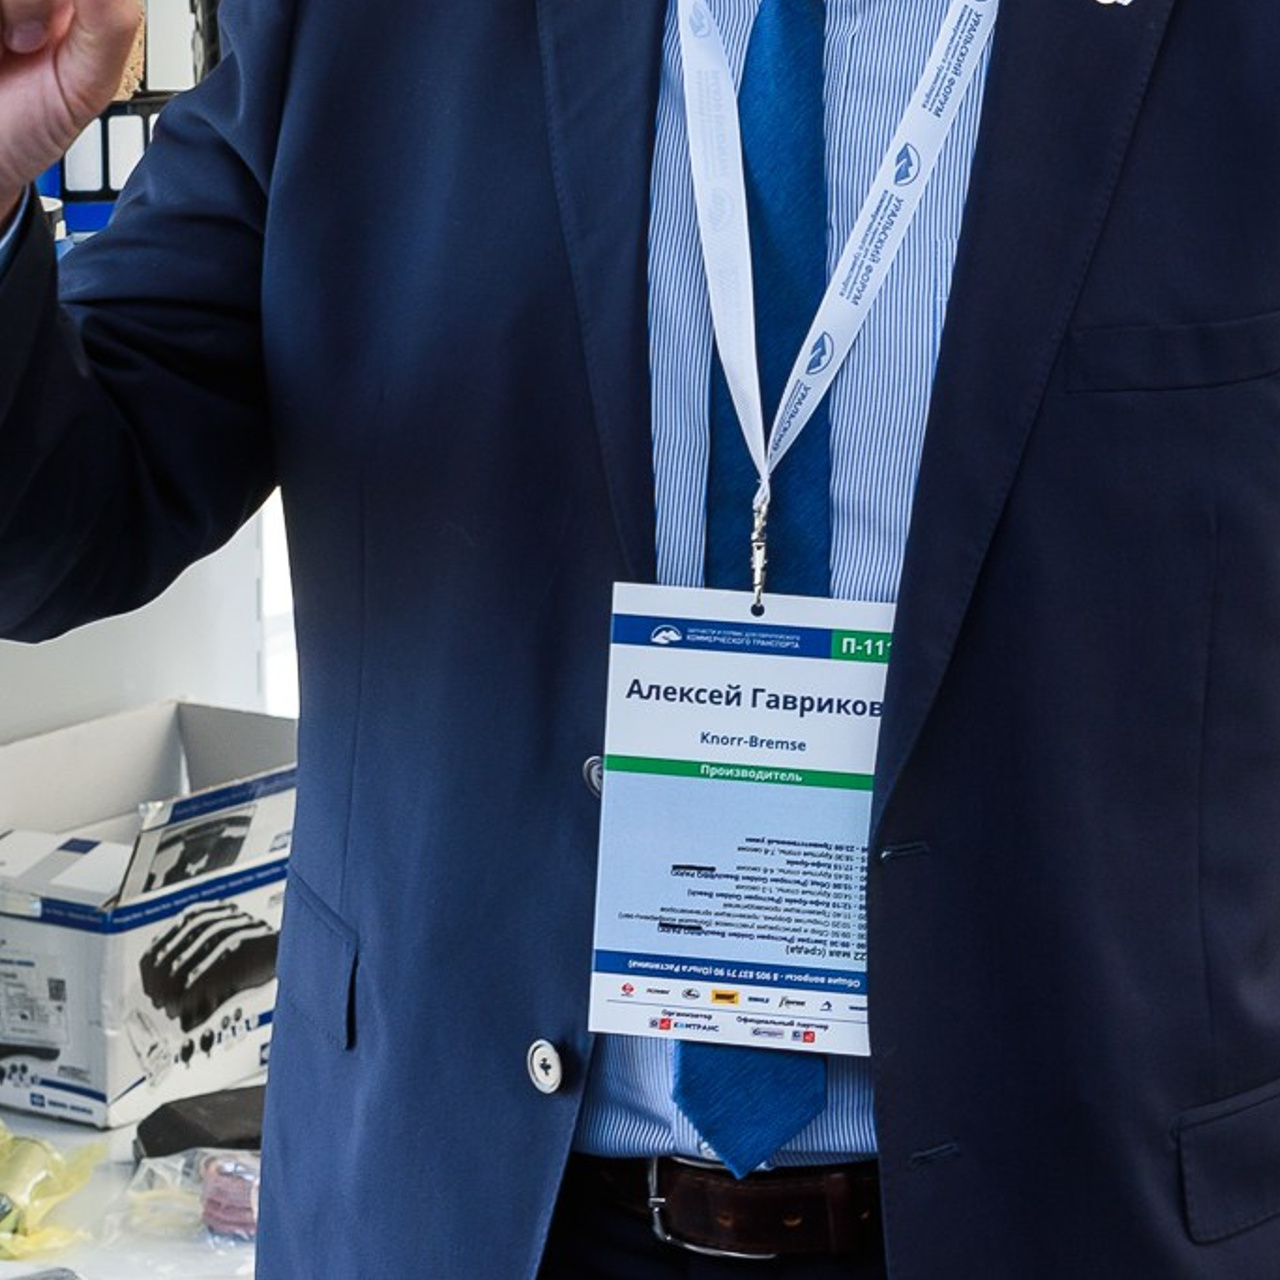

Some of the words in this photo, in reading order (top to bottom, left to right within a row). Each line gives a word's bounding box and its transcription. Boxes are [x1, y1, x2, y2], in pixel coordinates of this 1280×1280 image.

[949, 11, 983, 77] УРАЛЬСКИЙ
[932, 76, 957, 118] ФОРУМ
[867, 196, 904, 264] УРАЛЬСКИЙ
[849, 263, 874, 306] ФОРУМ
[686, 633, 751, 646] КОММЕРЧЕСКОГО
[751, 638, 799, 649] ТРАНСПОРТА
[626, 678, 742, 707] Алексей
[750, 688, 884, 718] Гавриков
[700, 732, 807, 752] Knorr-Bremse
[700, 764, 803, 783] Производитель
[785, 945, 826, 957] (среда)
[828, 950, 851, 958] мая
[681, 964, 712, 975] (Ольга
[784, 971, 825, 984] вопросы
[827, 975, 860, 987] Общие
